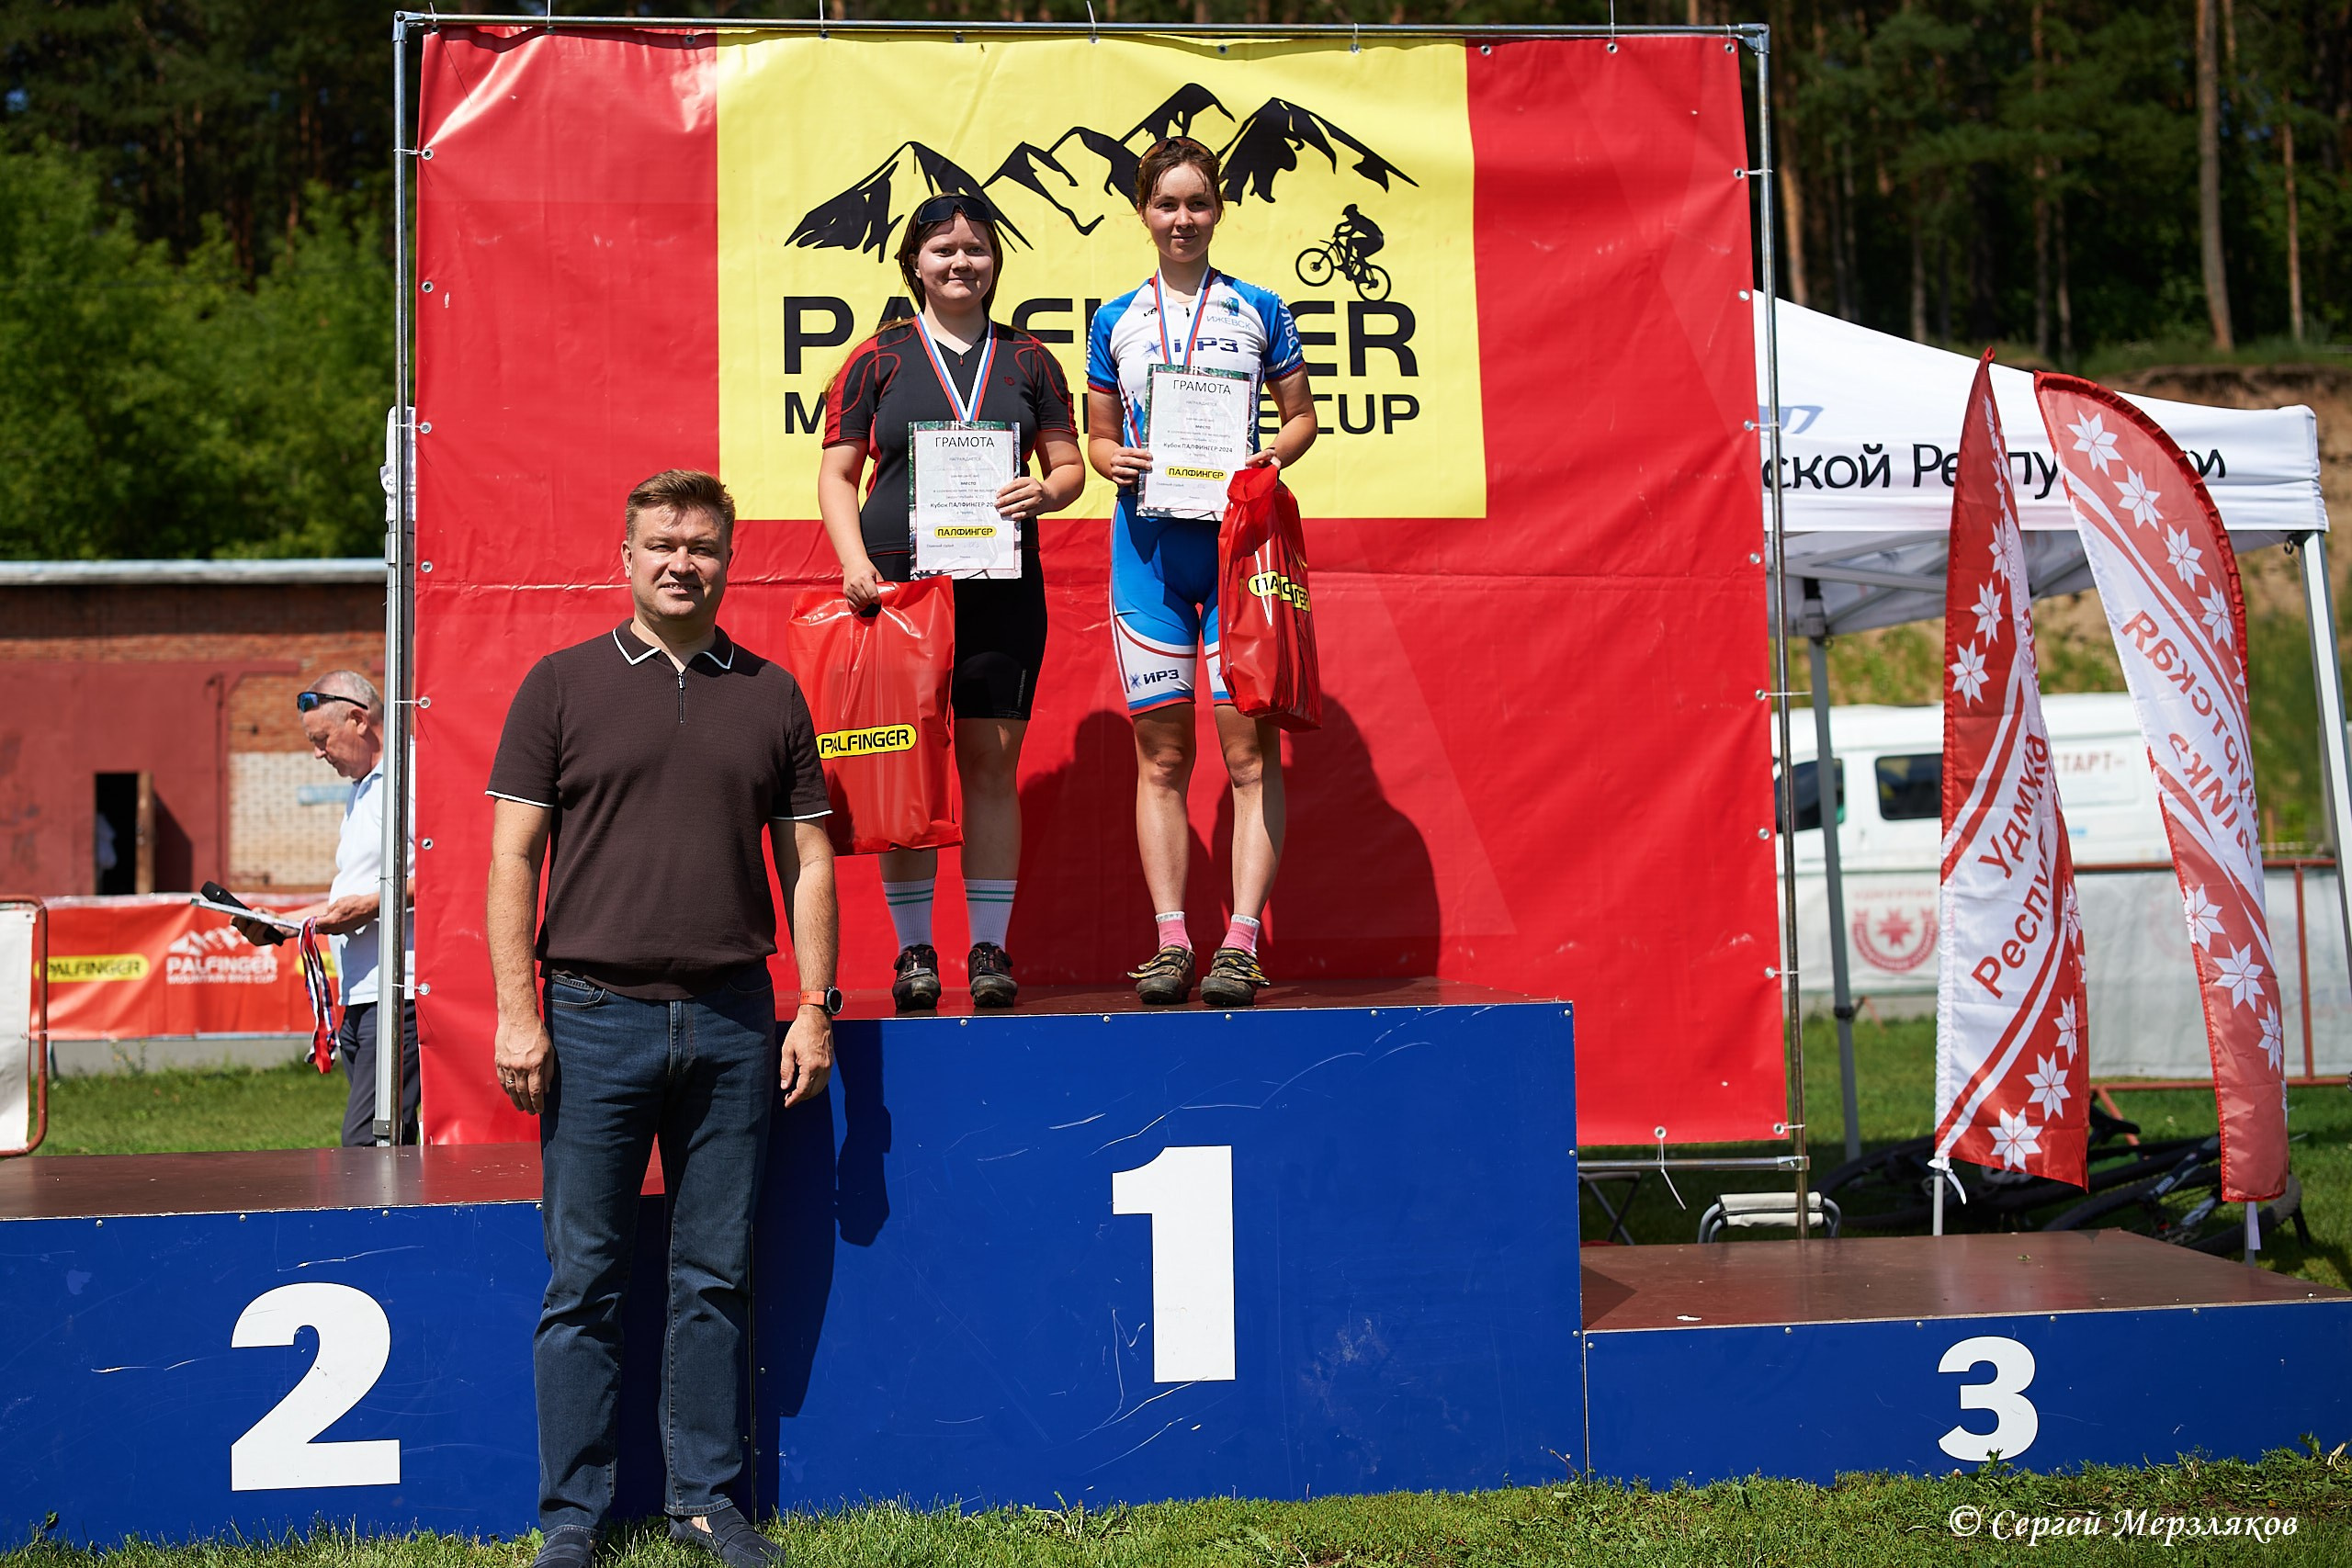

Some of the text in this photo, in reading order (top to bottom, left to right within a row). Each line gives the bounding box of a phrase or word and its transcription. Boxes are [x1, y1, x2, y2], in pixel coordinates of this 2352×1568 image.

[1206, 315, 1250, 330] ИЖЕВСК
[1173, 379, 1231, 395] ГРАМОТА
[935, 436, 994, 447] ГРАМОТА
[1169, 468, 1224, 479] ПАЛФИНГЕР
[937, 528, 993, 536] ПАЛФИНГЕР
[1143, 669, 1180, 685] ИРЗ
[820, 728, 910, 754] PALFINGER
[166, 955, 277, 976] PALFINGER
[1111, 1145, 1237, 1384] 1
[230, 1281, 401, 1493] 2
[1938, 1336, 2039, 1462] 3
